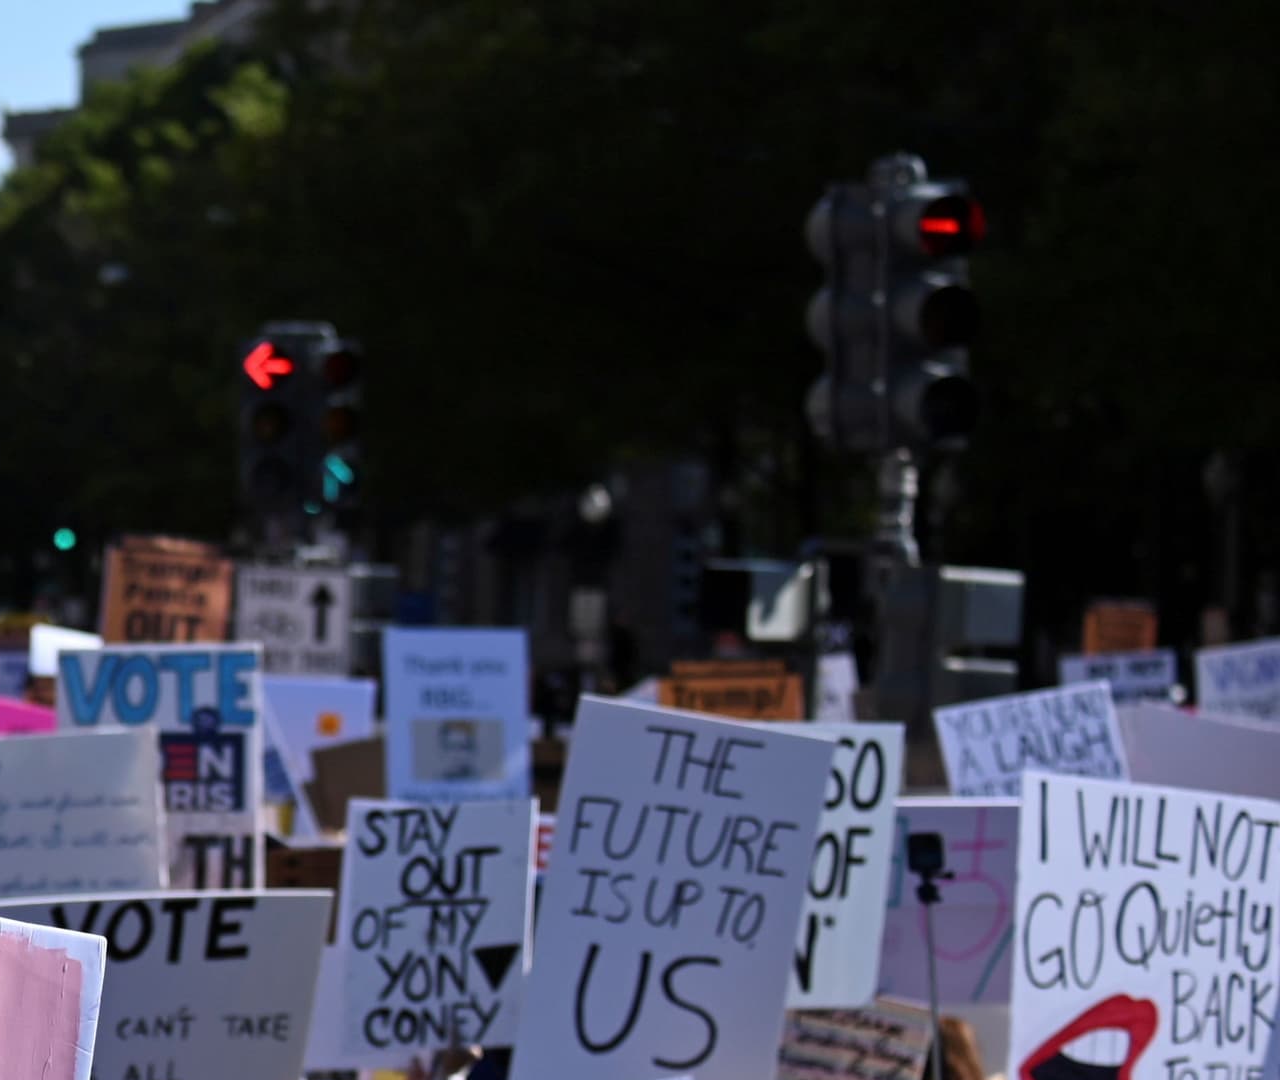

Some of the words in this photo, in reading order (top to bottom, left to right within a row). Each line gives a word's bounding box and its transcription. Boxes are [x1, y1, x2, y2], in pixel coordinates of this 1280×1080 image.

[56, 650, 258, 727] VOTE
[645, 723, 768, 802] THE
[355, 803, 462, 859] STAY
[568, 794, 801, 881] FUTURE
[807, 826, 875, 902] OF
[1039, 778, 1051, 864] I
[1076, 788, 1182, 871] WILL
[1188, 801, 1280, 885] NOT
[398, 844, 504, 900] OUT
[568, 867, 637, 926] IS
[642, 878, 705, 934] UP
[350, 903, 410, 952] OF
[424, 899, 490, 949] MY
[1022, 887, 1108, 993] GO
[1114, 880, 1276, 972] Quietly
[222, 1013, 292, 1042] TAKE
[571, 940, 726, 1073] US
[1170, 968, 1278, 1054] BACK
